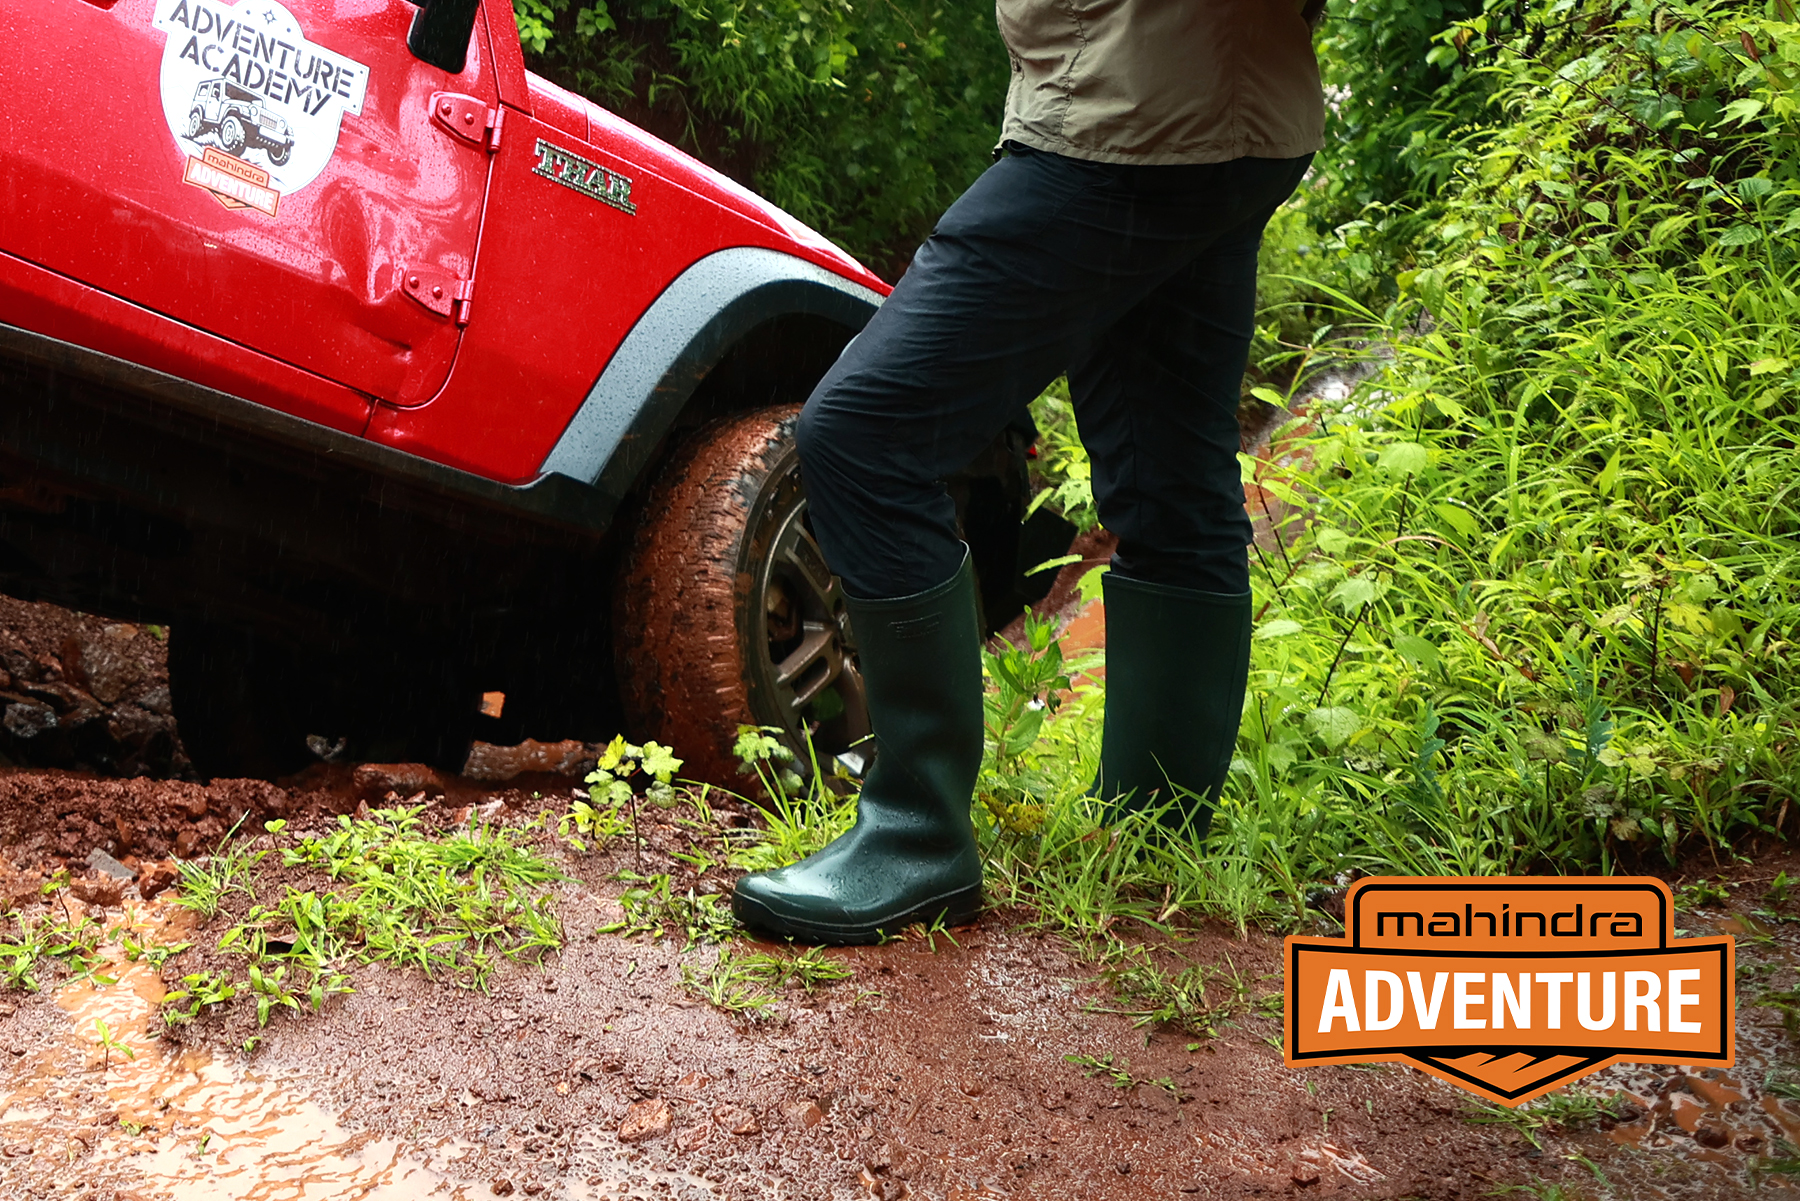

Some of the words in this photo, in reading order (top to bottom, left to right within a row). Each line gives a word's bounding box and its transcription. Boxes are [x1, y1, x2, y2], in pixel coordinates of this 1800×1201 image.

[179, 35, 332, 116] ACADEMY
[190, 162, 275, 211] ADVENTURE
[207, 153, 265, 183] mahindra
[531, 138, 637, 215] THAR
